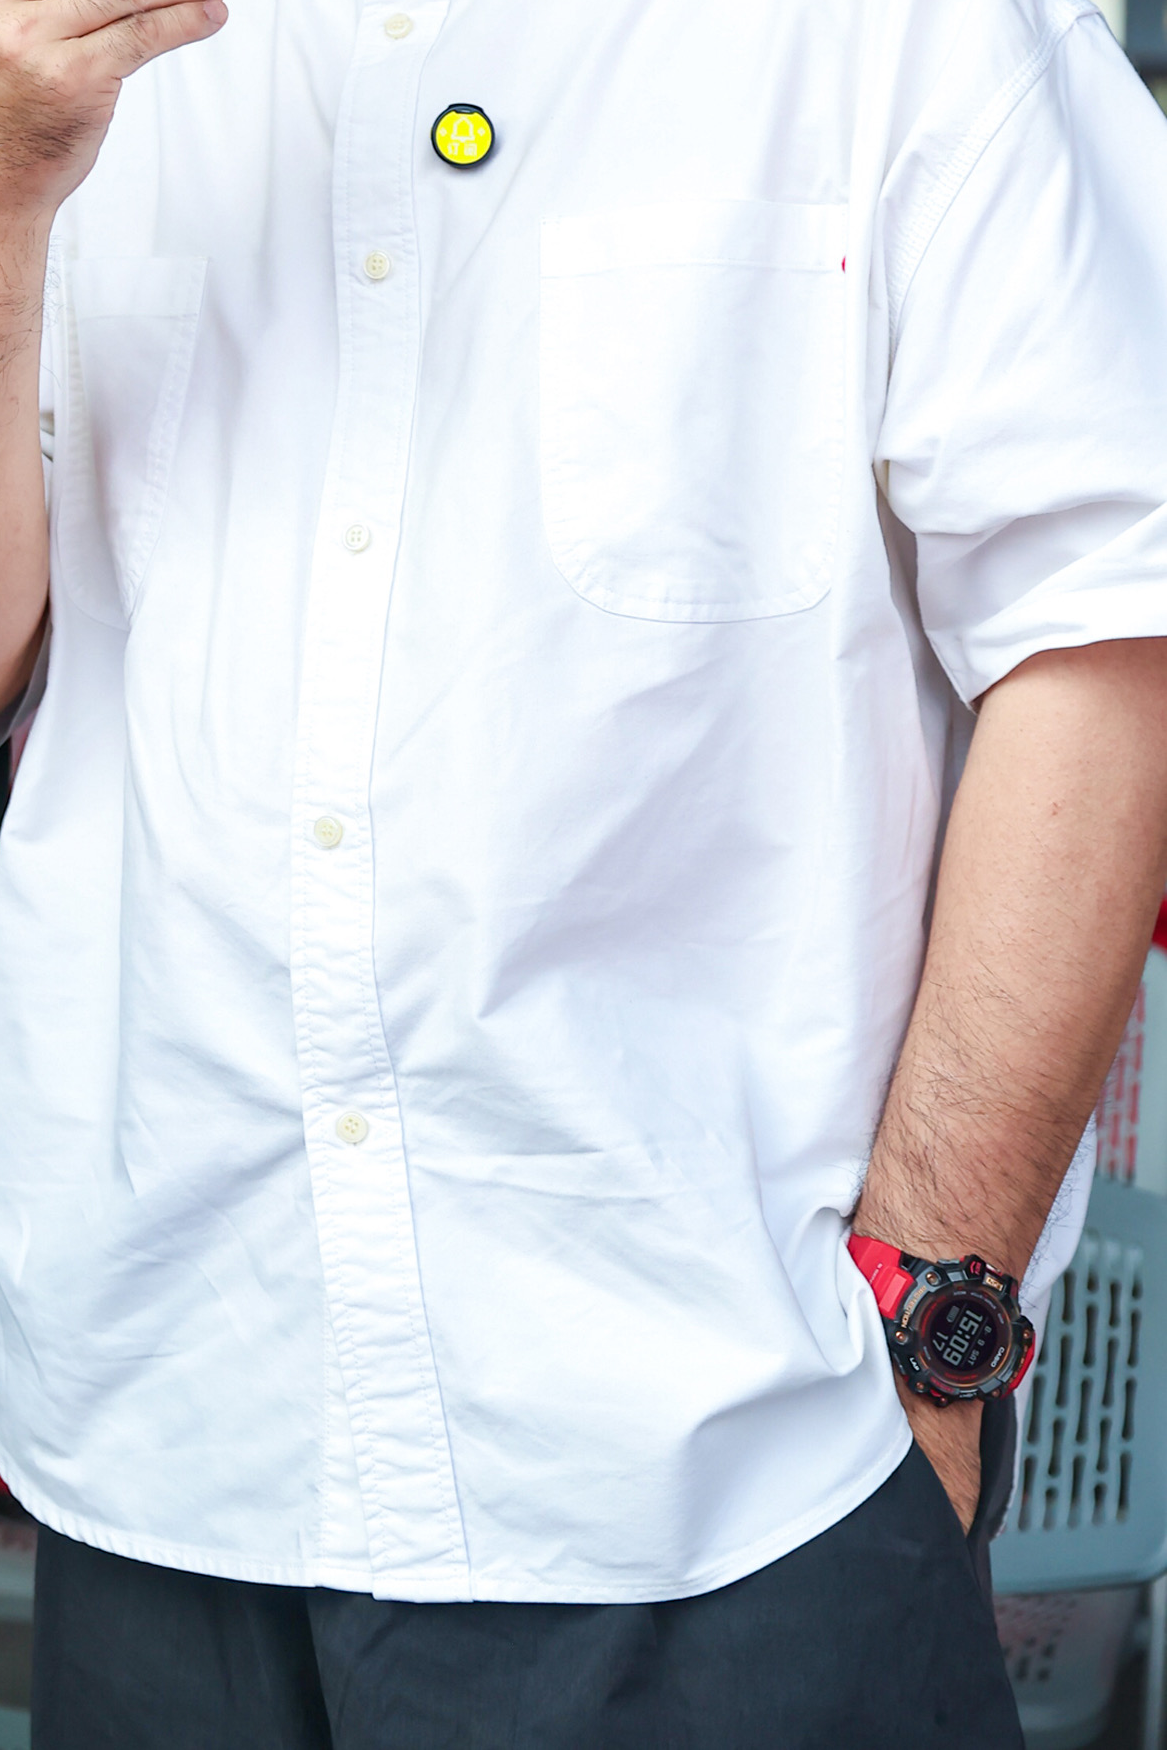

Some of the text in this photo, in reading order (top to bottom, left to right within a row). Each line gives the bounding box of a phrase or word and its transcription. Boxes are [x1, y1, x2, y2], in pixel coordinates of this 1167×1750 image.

[932, 1331, 949, 1351] 17
[942, 1310, 983, 1366] 15:09
[909, 1357, 920, 1371] LAP
[968, 1349, 979, 1366] SAT
[990, 1346, 1005, 1368] CASIO
